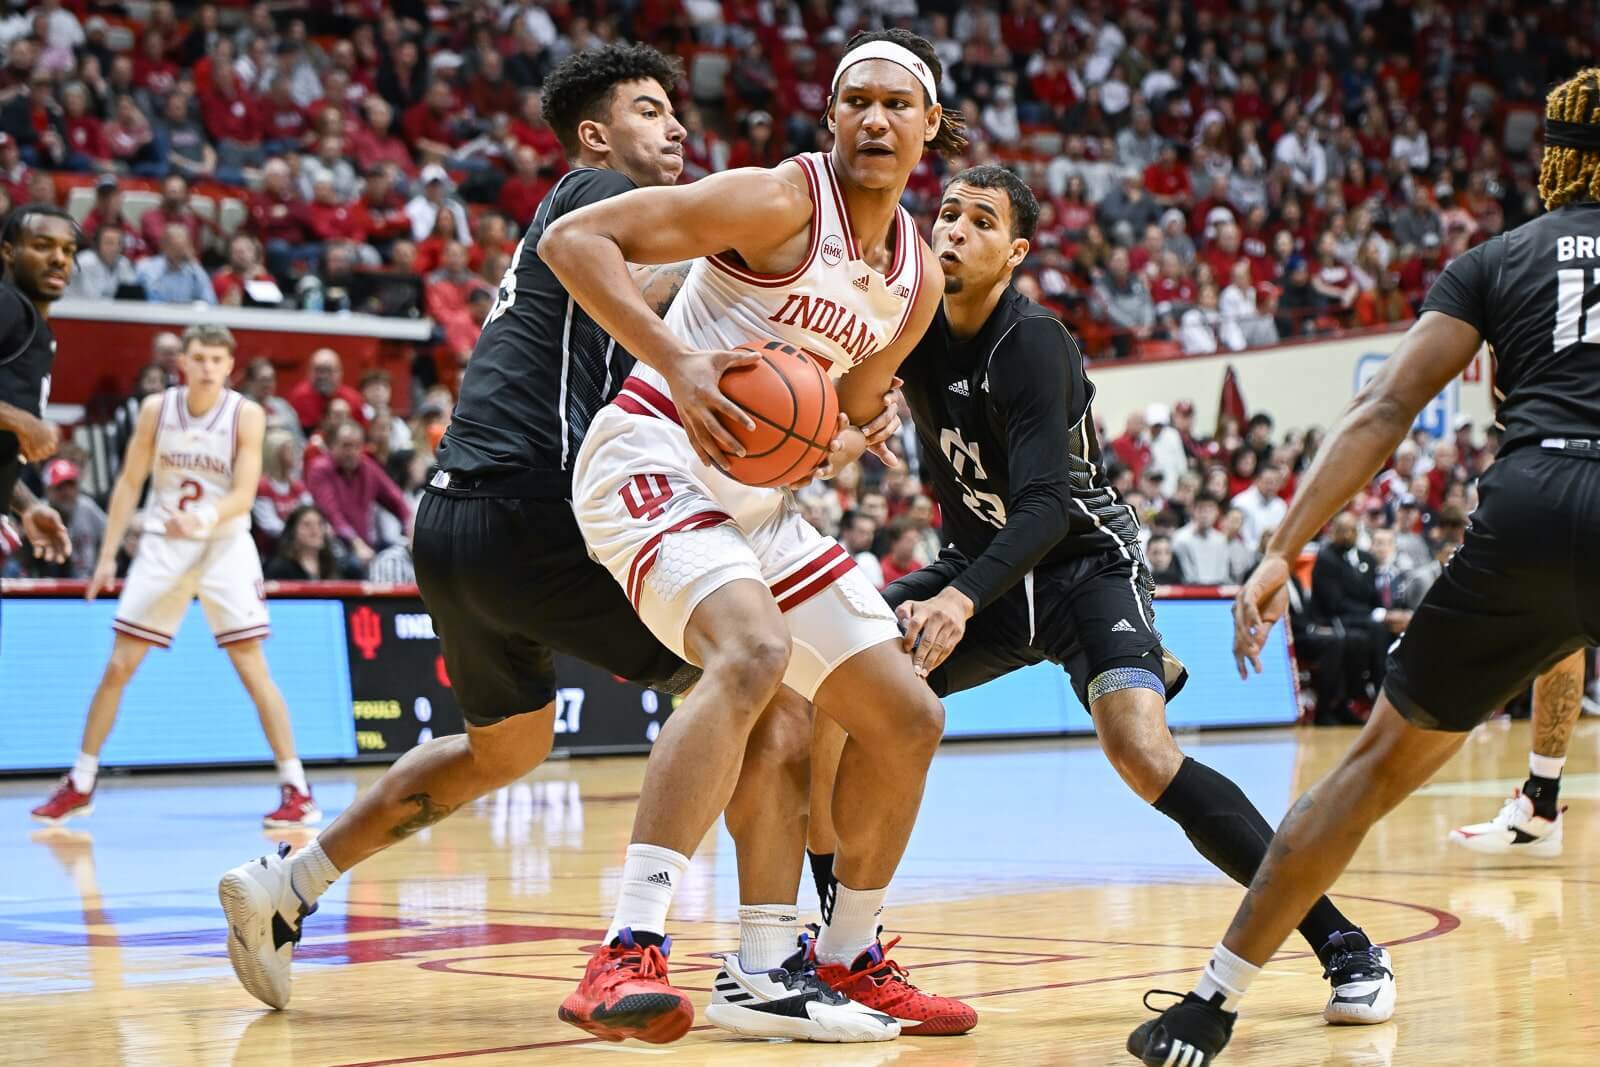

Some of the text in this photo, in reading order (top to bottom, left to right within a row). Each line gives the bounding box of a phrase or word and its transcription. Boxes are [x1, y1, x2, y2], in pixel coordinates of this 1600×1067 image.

[823, 243, 842, 259] RMK
[1557, 235, 1600, 262] BR
[353, 696, 432, 722] FOULS 0
[641, 689, 658, 714] 0
[357, 731, 387, 749] TOL
